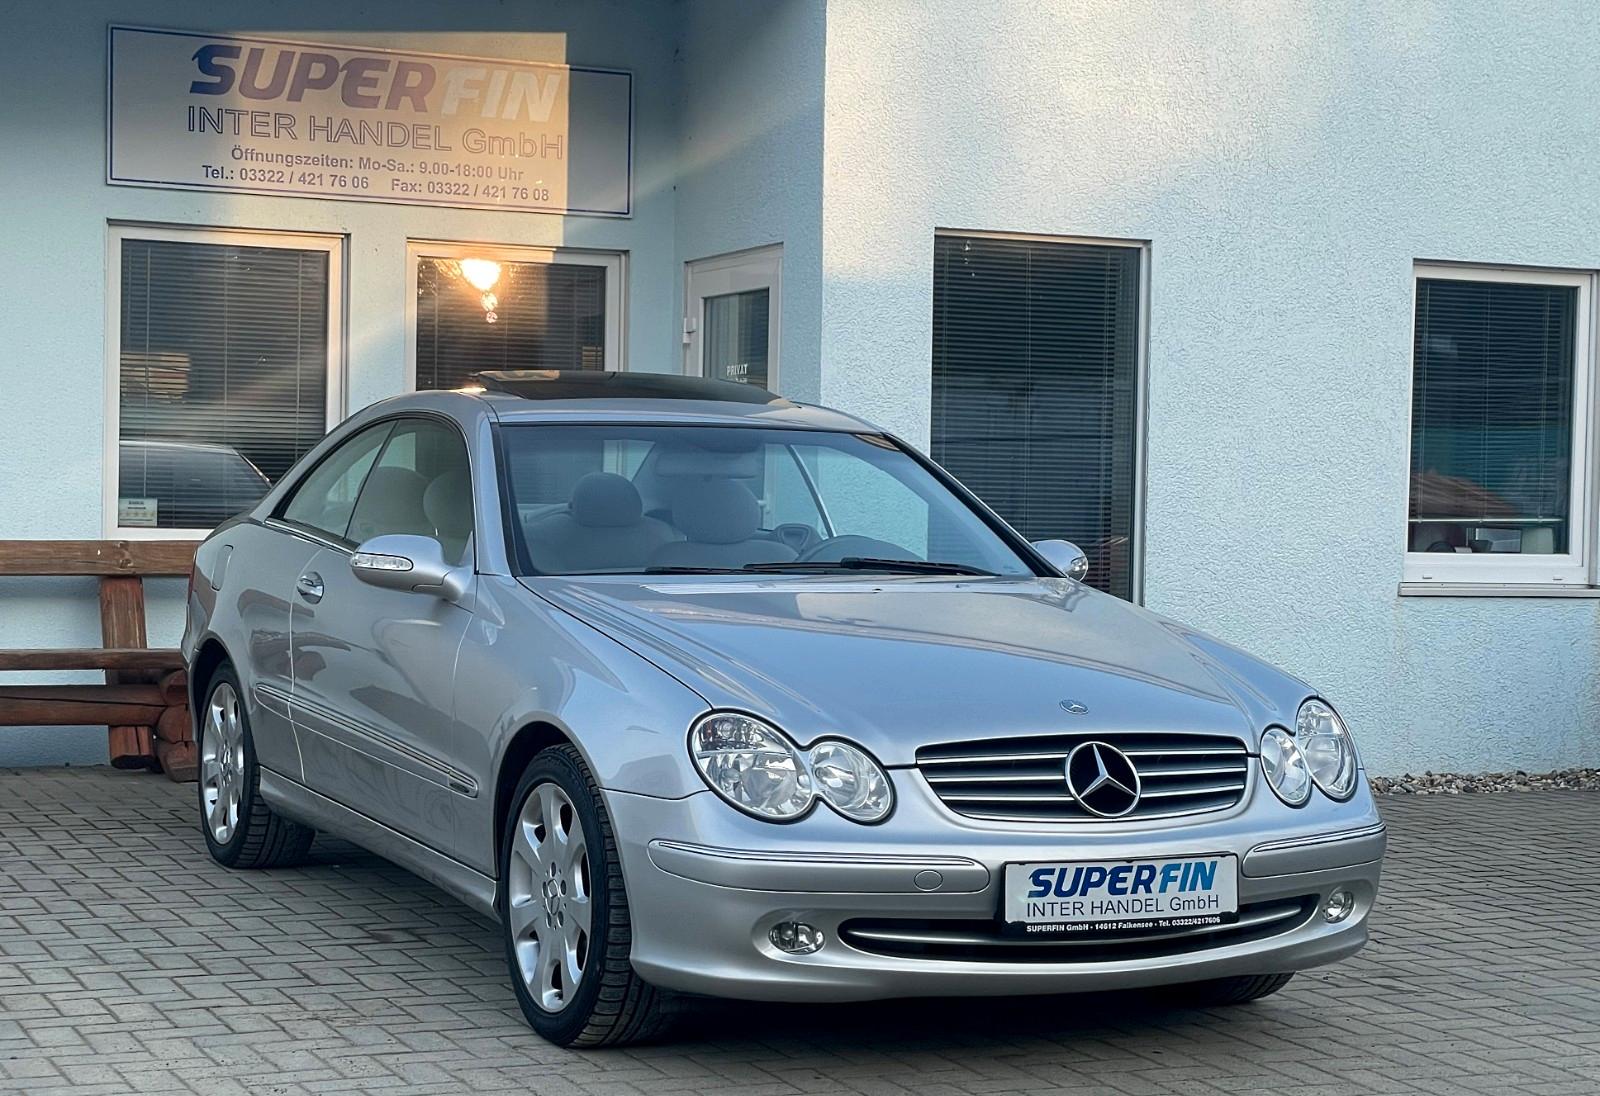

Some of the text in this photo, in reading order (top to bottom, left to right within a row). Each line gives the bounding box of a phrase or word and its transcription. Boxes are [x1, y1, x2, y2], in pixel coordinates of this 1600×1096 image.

[190, 44, 562, 122] SUPERFIN
[188, 106, 563, 160] INTER HANDEL GmbH
[231, 145, 524, 181] Öffnungszeiten: Mo-Sa.: 9.00-18:00 Uhr
[202, 164, 234, 180] Tel.:
[239, 168, 285, 184] 03322
[298, 172, 323, 186] 421
[329, 174, 347, 188] 76
[352, 176, 369, 189] 06
[391, 178, 422, 193] Fax:
[427, 181, 470, 196] 03322
[482, 185, 507, 199] 421
[512, 187, 528, 200] 76
[533, 188, 549, 201] 08
[726, 363, 748, 376] PRIVAT
[1027, 861, 1218, 898] SUPERFIN
[1027, 894, 1219, 917] INTER HANDEL GmbH
[1026, 924, 1064, 932] SUPERFIN
[1066, 923, 1088, 931] GmbH
